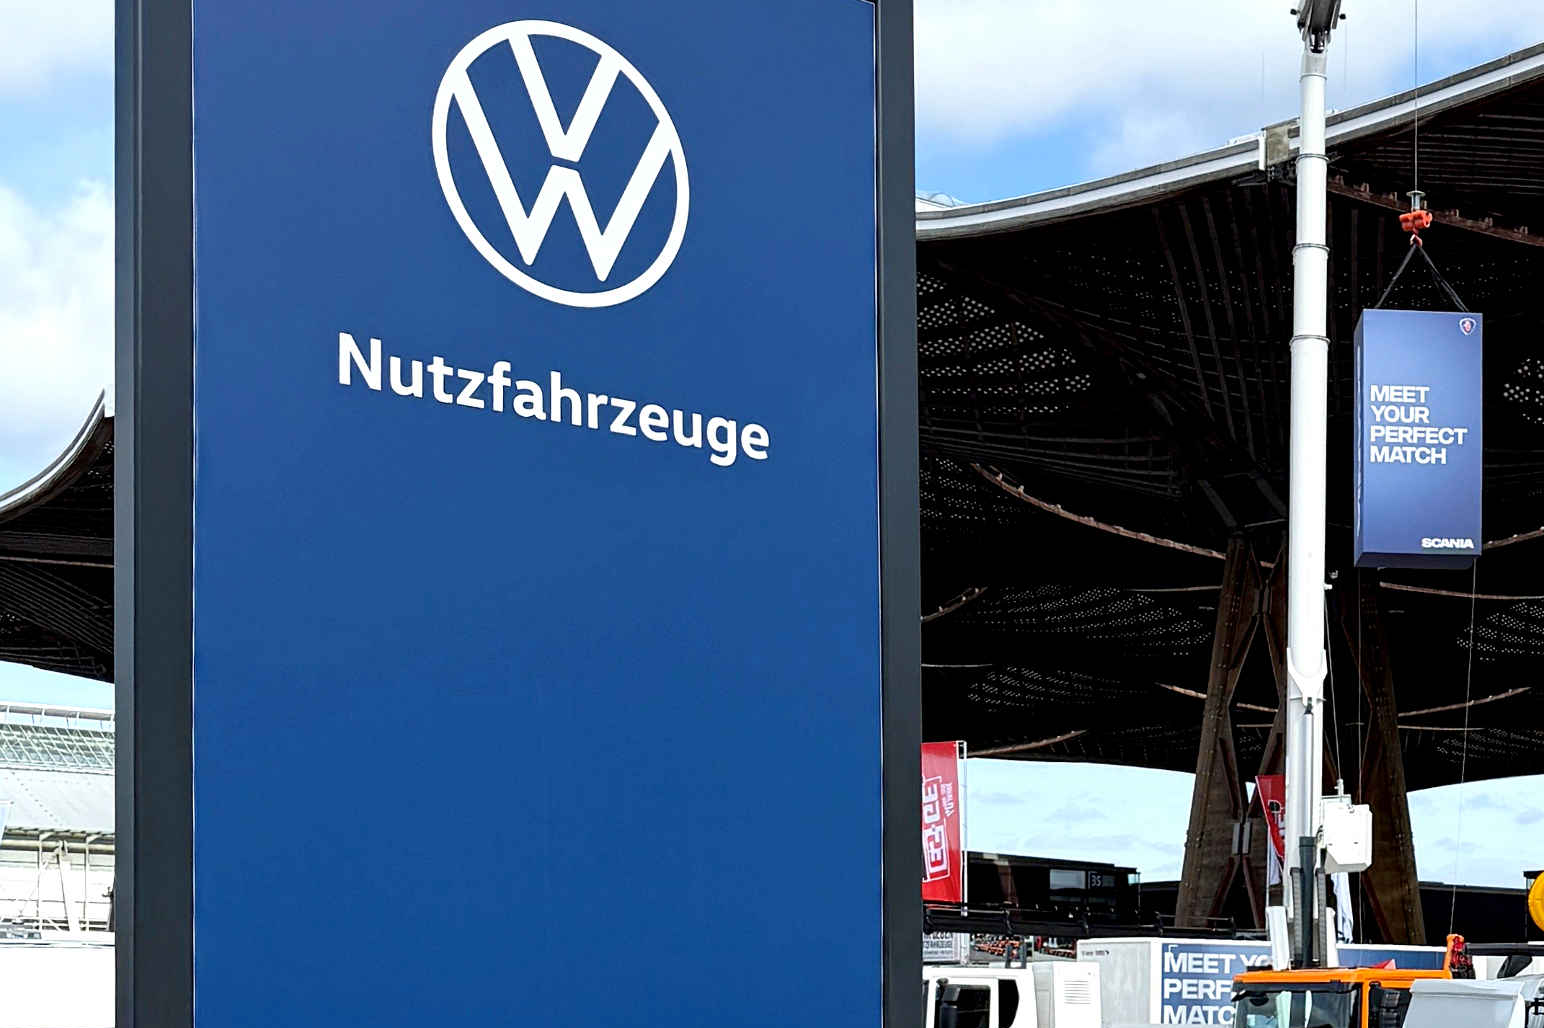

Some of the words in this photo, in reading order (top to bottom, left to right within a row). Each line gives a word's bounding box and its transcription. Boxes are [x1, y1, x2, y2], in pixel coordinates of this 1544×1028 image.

[338, 332, 770, 467] Nutzfahrzeuge
[1370, 384, 1430, 403] MEET
[1370, 405, 1430, 424] YOUR
[1370, 425, 1468, 445] PERFECT
[1370, 446, 1447, 465] MATCH
[1421, 537, 1474, 549] SCANIA
[1164, 952, 1236, 974] MEET
[1240, 954, 1273, 967] YO
[1164, 979, 1233, 1000] PERF
[1163, 1004, 1235, 1024] MATC
